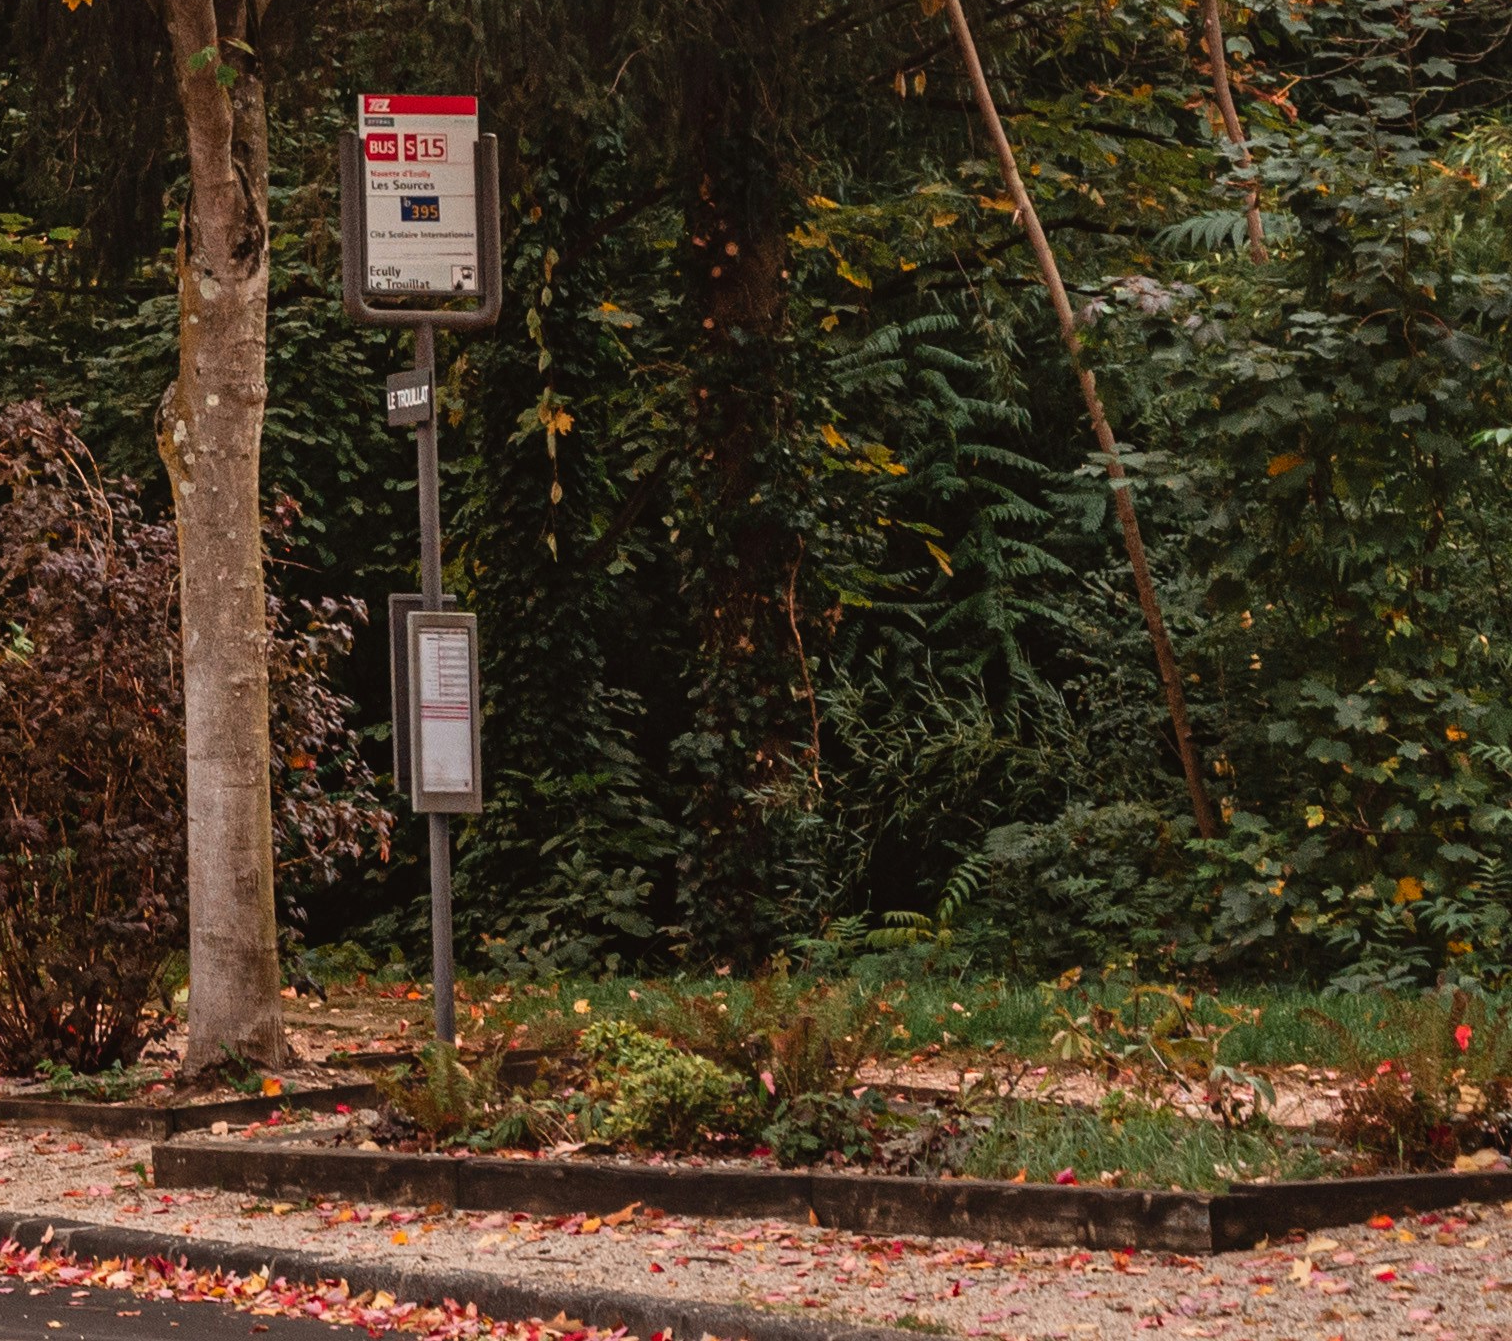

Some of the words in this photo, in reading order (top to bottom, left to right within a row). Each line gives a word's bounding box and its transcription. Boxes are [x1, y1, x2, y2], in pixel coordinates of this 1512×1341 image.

[369, 140, 396, 155] BUS
[420, 138, 445, 158] 15
[371, 180, 389, 190] Les
[393, 180, 435, 190] Sources
[412, 205, 439, 219] 395
[388, 230, 418, 238] Scolaire
